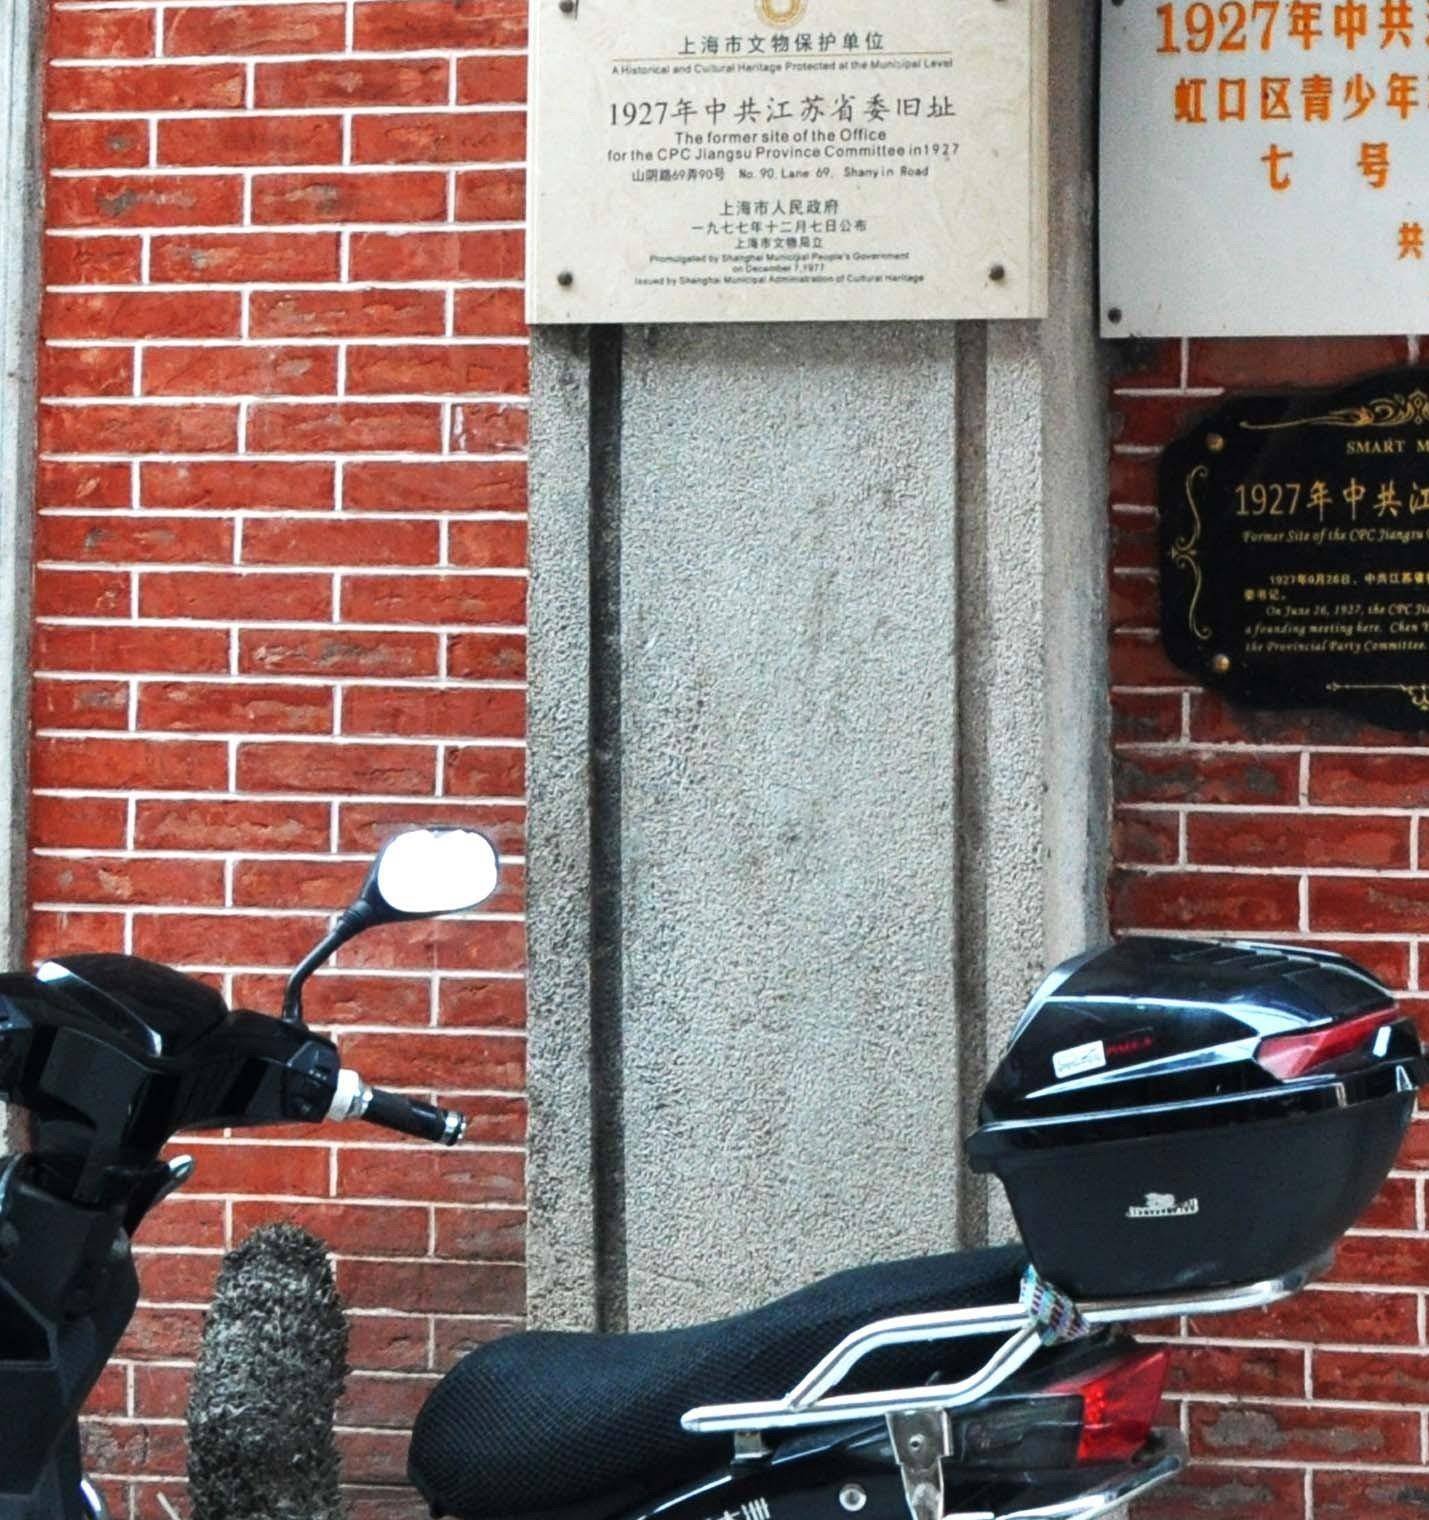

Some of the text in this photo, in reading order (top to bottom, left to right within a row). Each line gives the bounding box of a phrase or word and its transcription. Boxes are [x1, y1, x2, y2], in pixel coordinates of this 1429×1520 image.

[678, 32, 884, 55] 上海市文物保护单位
[621, 64, 670, 75] Historical
[673, 64, 691, 74] and
[694, 63, 735, 74] Cultural
[738, 62, 781, 75] Heritage
[785, 61, 836, 72] Protected
[839, 60, 848, 70] at
[851, 60, 867, 70] the
[870, 59, 920, 70] Municipal
[924, 58, 953, 68] Level
[610, 92, 957, 127] 1927年中共江苏省委旧址
[675, 128, 887, 145] The former site of the Office
[608, 149, 626, 162] for
[631, 148, 653, 161] the
[657, 147, 691, 161] CPC
[695, 146, 752, 163] Jiangsu
[756, 145, 821, 160] Province
[824, 144, 905, 158] Committee
[781, 167, 809, 179] Lane
[900, 165, 929, 177] Road
[720, 199, 839, 217] 上海市人民政府
[691, 220, 867, 235] 一九七七年十二月七日公布
[722, 254, 763, 265] Shanghai
[853, 252, 910, 261] Government
[847, 274, 883, 283] Cultural
[1346, 439, 1406, 454] SMART
[1243, 530, 1285, 543] Former
[1287, 529, 1311, 543] Site
[1312, 528, 1326, 544] of
[1328, 528, 1345, 542] the
[1349, 528, 1376, 542] CPC
[1378, 528, 1423, 543] Jiangsu
[1266, 607, 1281, 616] On
[1286, 606, 1310, 617] June
[1368, 604, 1385, 615] the
[1388, 603, 1413, 616] CPC
[1252, 622, 1305, 638] founding
[1309, 622, 1353, 637] meeting
[1390, 621, 1418, 633] Chen
[1245, 641, 1263, 652] the
[1266, 640, 1327, 652] Provincial
[1329, 640, 1361, 654] Party
